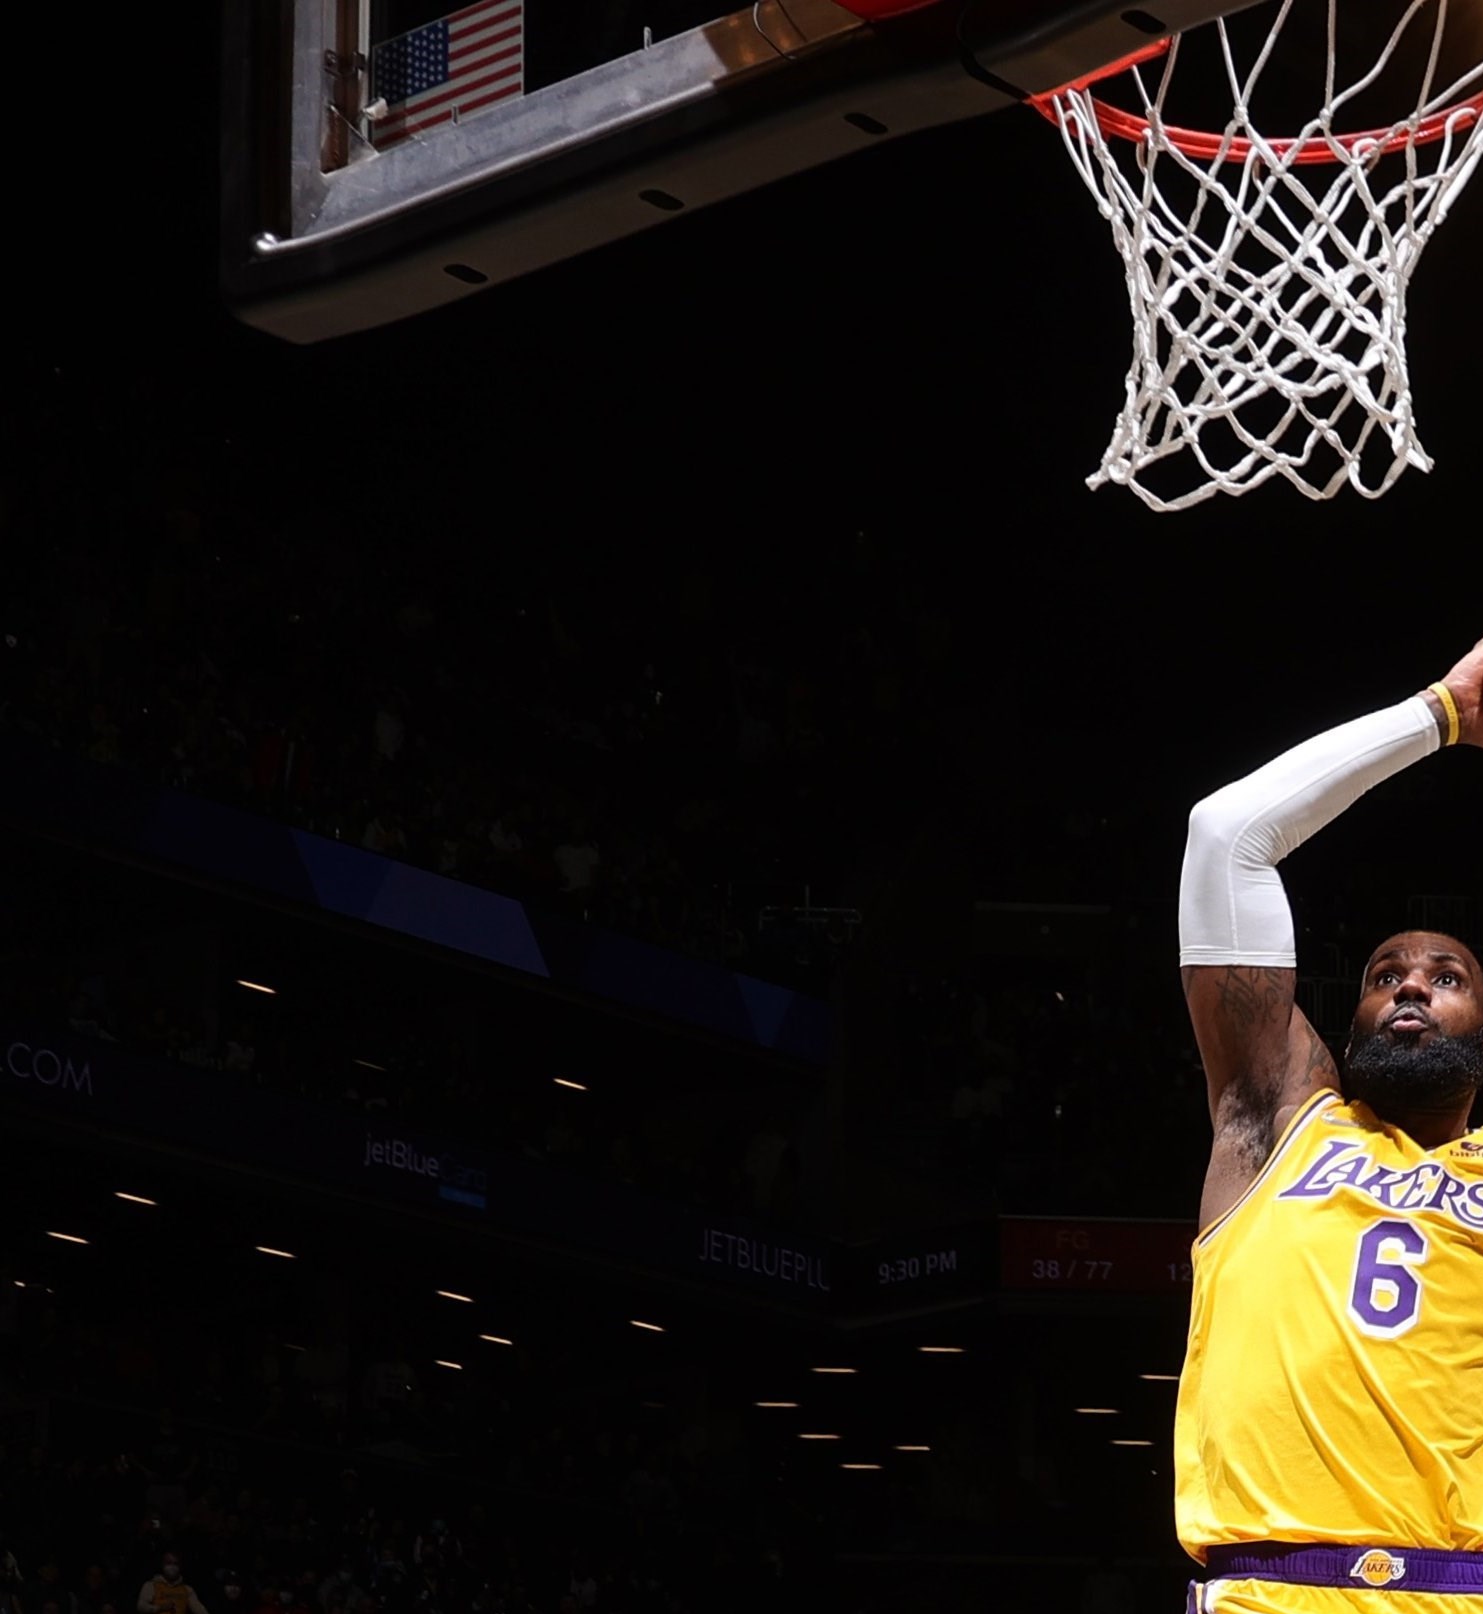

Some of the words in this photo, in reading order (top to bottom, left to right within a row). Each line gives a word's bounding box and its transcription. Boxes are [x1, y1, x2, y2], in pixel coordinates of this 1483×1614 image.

[878, 1258, 920, 1285] 9:30
[926, 1250, 958, 1276] PM
[1032, 1259, 1061, 1280] 38
[1084, 1261, 1113, 1281] 77
[1350, 1219, 1426, 1334] 6
